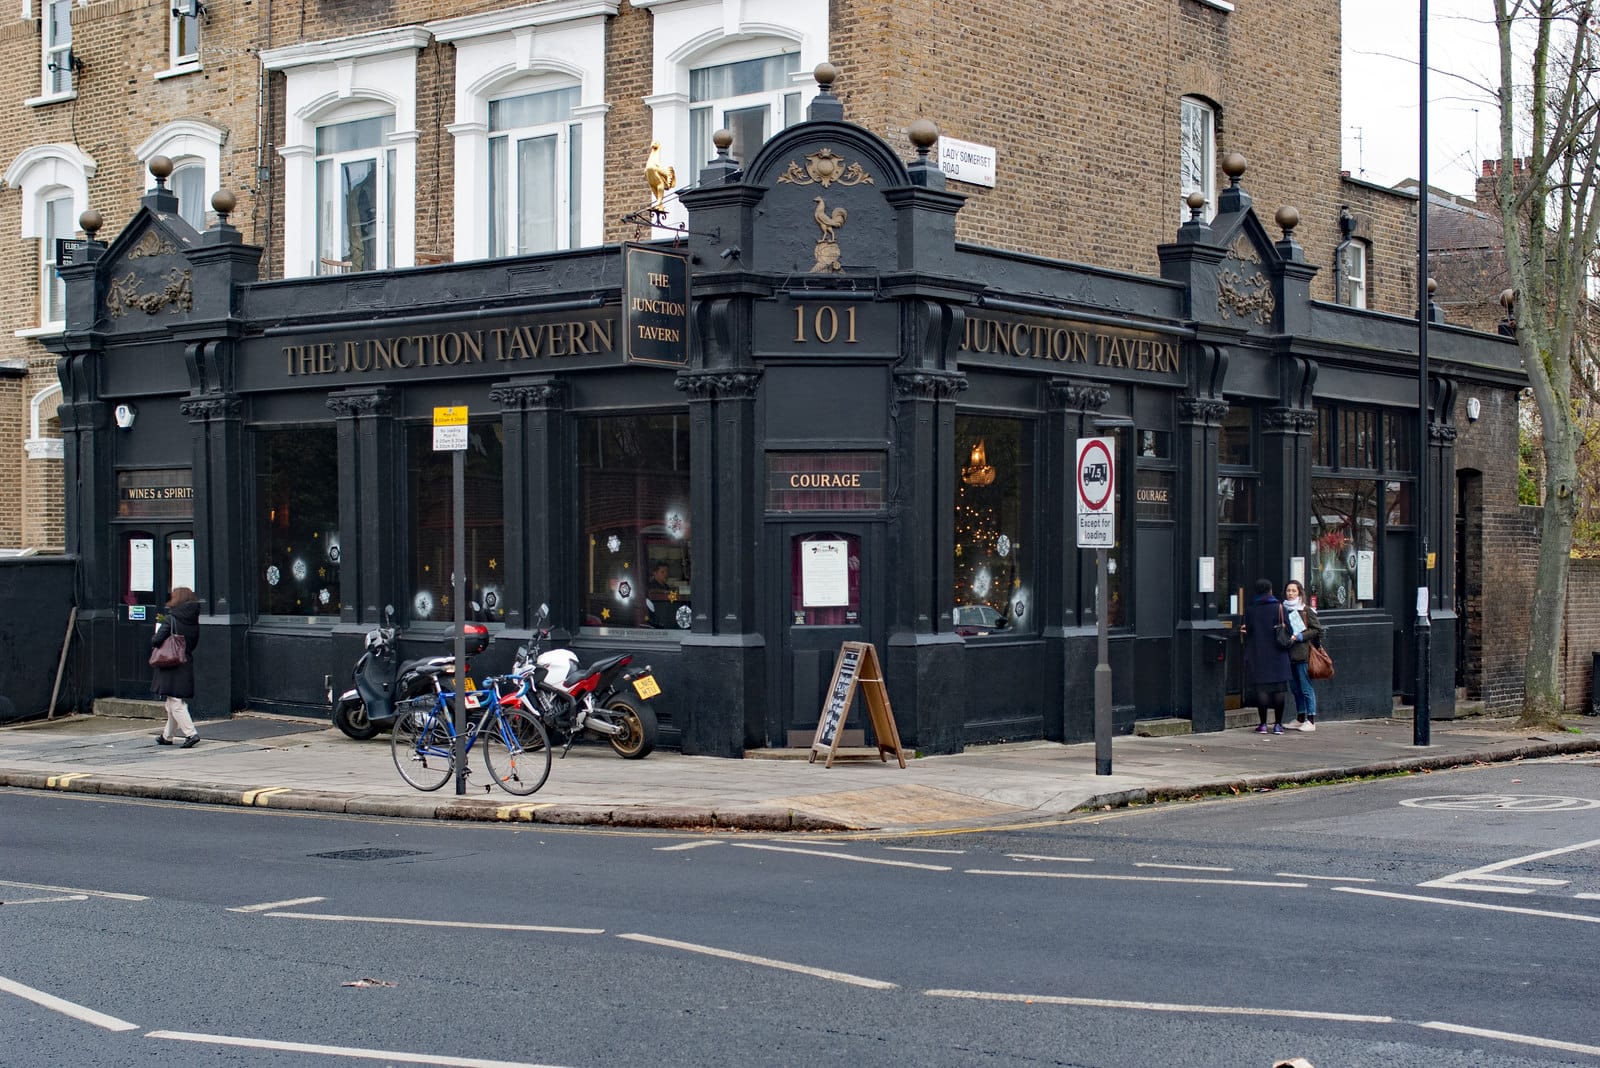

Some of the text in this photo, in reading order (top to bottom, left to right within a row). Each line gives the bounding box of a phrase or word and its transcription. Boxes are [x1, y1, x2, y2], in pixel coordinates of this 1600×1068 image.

[942, 146, 992, 168] LADY SOMERSET
[942, 161, 960, 175] ROAD
[647, 271, 670, 288] THE
[631, 297, 686, 317] JUNCTION
[792, 304, 861, 343] 101
[637, 325, 680, 342] TAVERN
[282, 318, 615, 376] THE JUNCTION TAVERN
[961, 316, 1182, 374] JUNCTION TAVERN
[790, 473, 861, 487] COURAGE
[128, 488, 155, 499] WINES
[157, 490, 162, 499] &
[1136, 489, 1168, 502] COURAGE
[1080, 518, 1111, 529] Except for
[1084, 530, 1107, 541] loading
